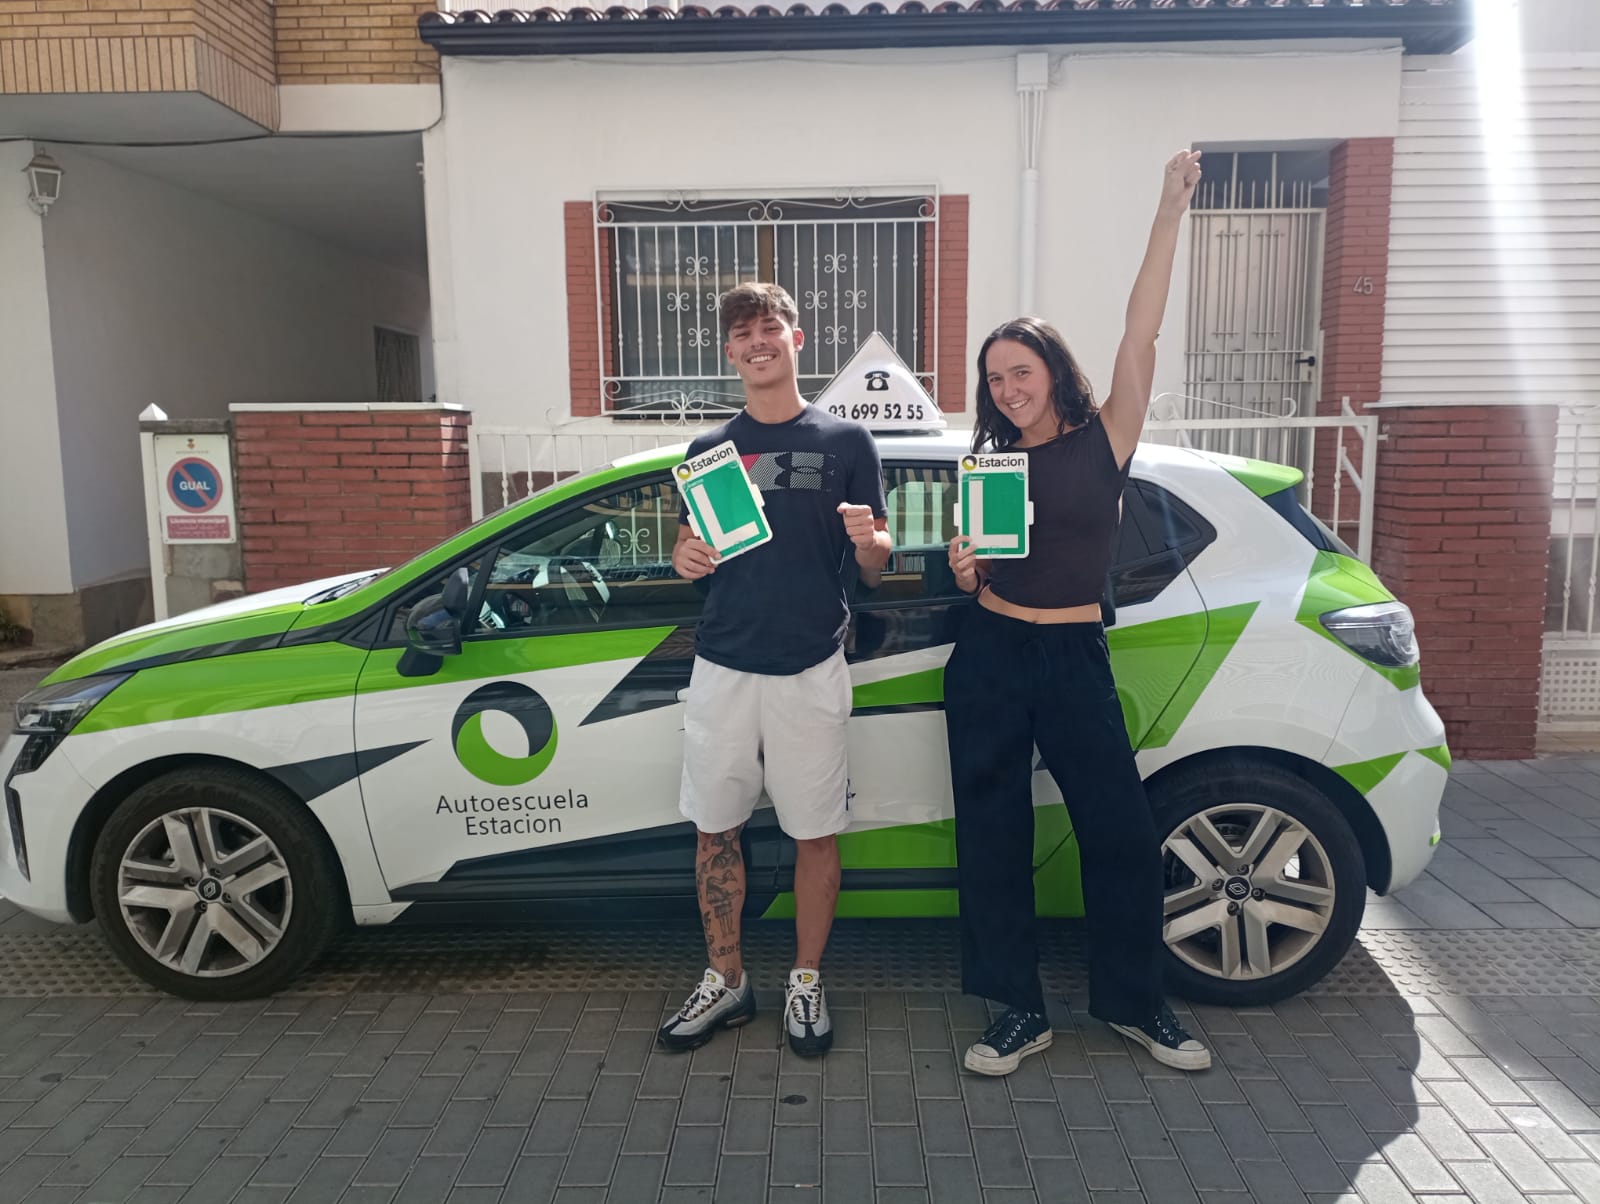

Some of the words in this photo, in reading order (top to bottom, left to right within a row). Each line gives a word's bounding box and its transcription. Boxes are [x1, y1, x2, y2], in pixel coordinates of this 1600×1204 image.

[1353, 276, 1373, 295] 45
[829, 404, 846, 419] 93
[851, 403, 879, 420] 699
[884, 403, 902, 420] 52
[907, 405, 924, 420] 55
[691, 446, 734, 473] Estacion
[979, 456, 1025, 468] Estacion
[179, 481, 210, 490] GUAL
[690, 483, 760, 552] L
[969, 479, 1019, 549] L
[436, 789, 589, 815] Autoescuela
[465, 813, 562, 836] Estacion
